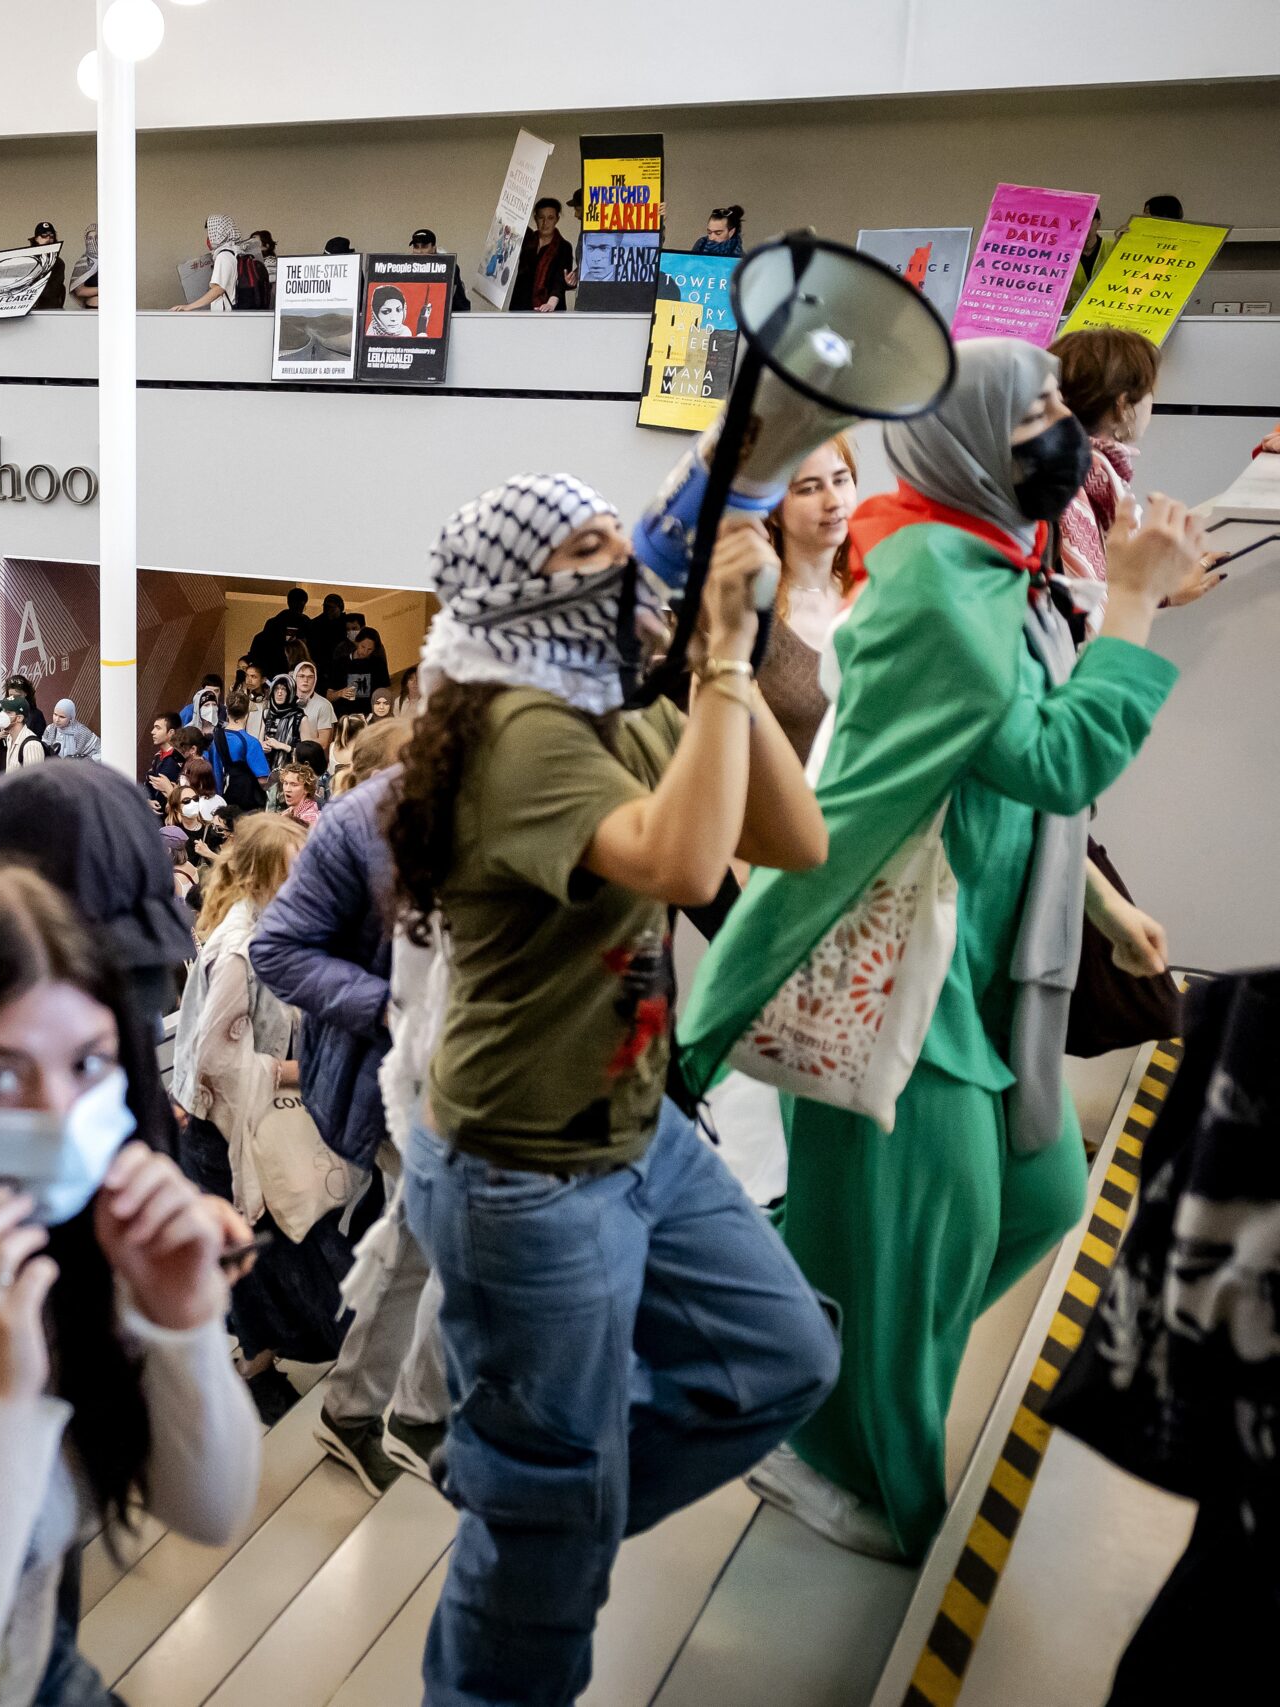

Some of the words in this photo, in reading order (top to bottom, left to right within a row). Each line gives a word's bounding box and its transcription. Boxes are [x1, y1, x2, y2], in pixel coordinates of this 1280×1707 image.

[611, 174, 625, 186] THE
[502, 190, 529, 215] PALESTINE
[589, 185, 650, 204] WRETCHED
[586, 212, 599, 221] THE
[600, 203, 658, 230] EARTH
[588, 203, 597, 213] OF
[992, 210, 1059, 228] ANGELA
[1069, 219, 1082, 232] Y.
[1006, 228, 1058, 245] DAVIS
[983, 242, 1051, 260] FREEDOM
[1057, 252, 1071, 263] IS
[1156, 242, 1178, 251] THE
[611, 246, 660, 265] FRANTZ
[1120, 252, 1197, 269] HUNDRED
[286, 265, 302, 279] THE
[304, 264, 348, 279] ONE-STATE
[375, 262, 386, 274] My
[387, 262, 412, 274] People
[412, 262, 430, 273] Shall
[431, 262, 447, 273] Live
[615, 263, 658, 282] FANON
[887, 264, 950, 273] STICE
[975, 258, 985, 268] A
[992, 260, 1068, 279] CONSTANT
[1122, 269, 1178, 282] YEARS'
[285, 280, 331, 294] CONDITION
[665, 273, 727, 290] TOWER
[980, 275, 1054, 294] STRUGGLE
[6, 293, 36, 303] CAGE
[688, 291, 711, 303] OF
[1107, 283, 1143, 296] WAR
[1150, 289, 1174, 300] ON
[671, 303, 726, 320] IVORY
[963, 300, 979, 308] AND
[982, 302, 995, 310] THE
[1087, 297, 1175, 317] PALESTINE
[677, 322, 714, 334] AND
[993, 316, 1039, 327] MOVEMENT
[671, 336, 718, 351] STEEL
[368, 352, 386, 363] LEILA
[386, 353, 413, 364] KHALED
[665, 366, 713, 382] MAYA
[662, 380, 712, 397] WIND
[12, 600, 47, 676] A
